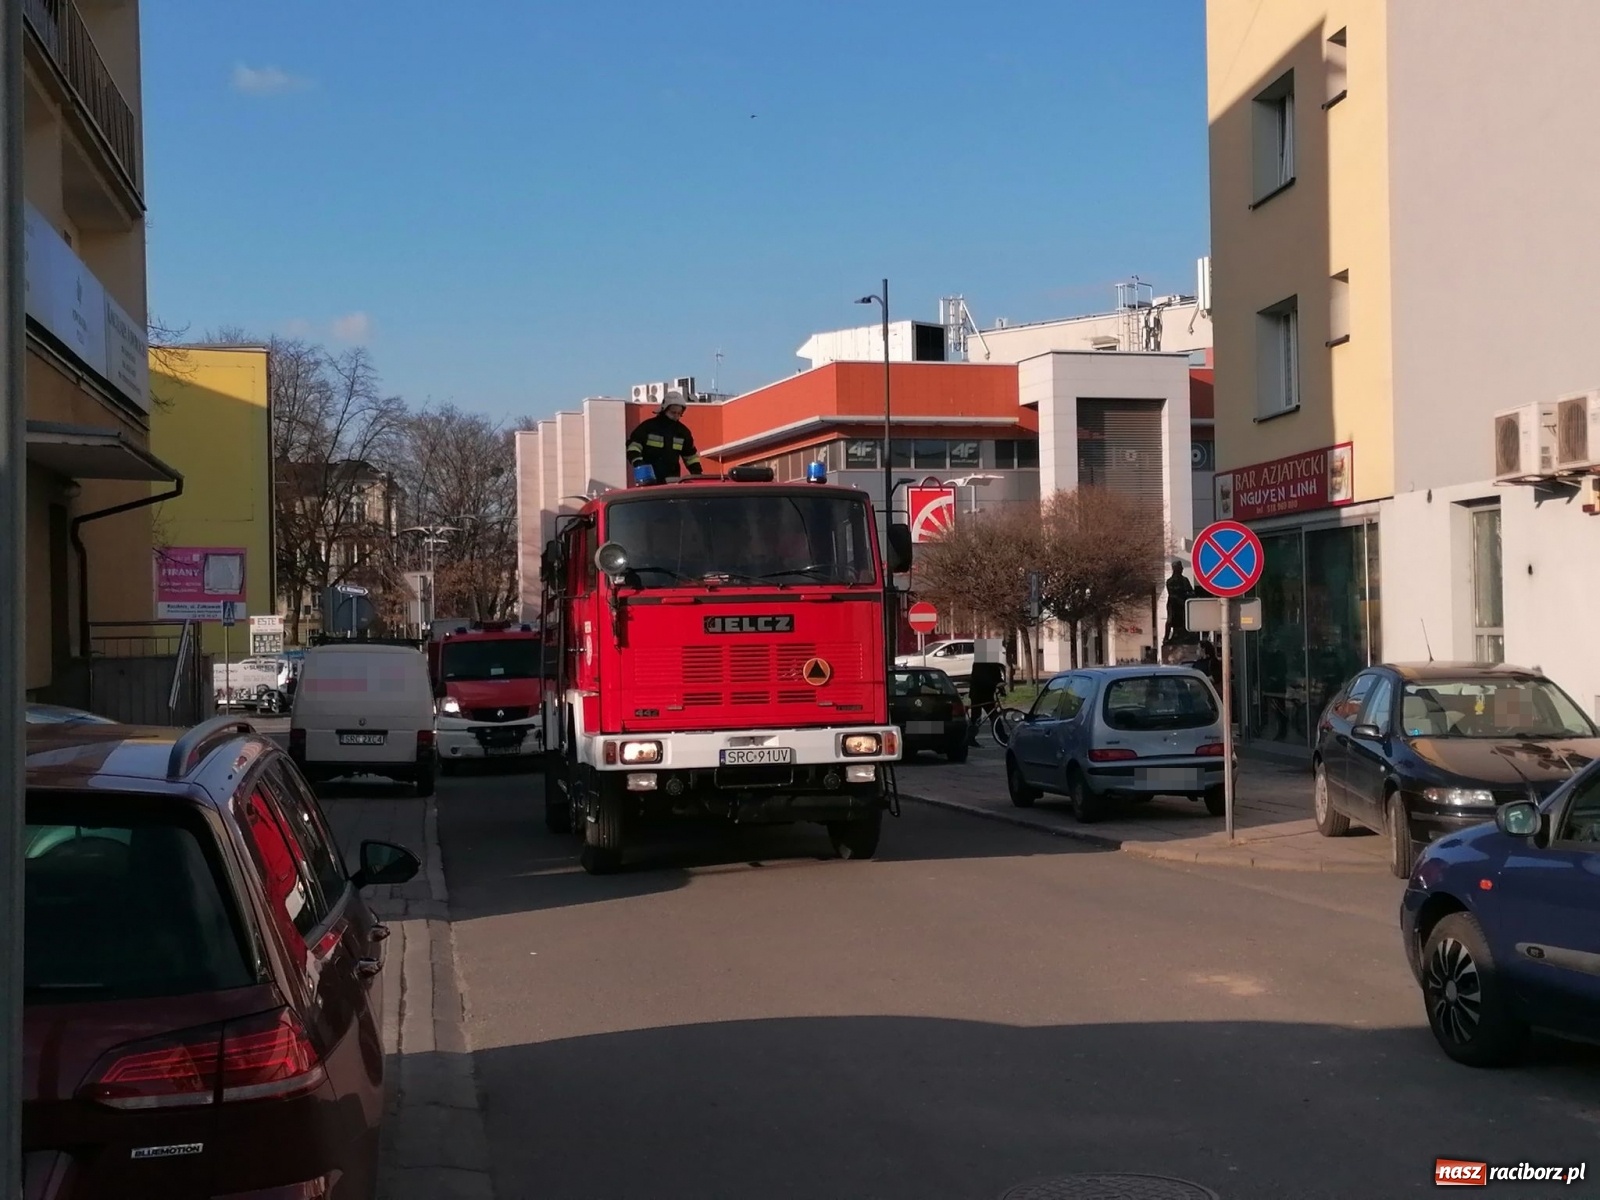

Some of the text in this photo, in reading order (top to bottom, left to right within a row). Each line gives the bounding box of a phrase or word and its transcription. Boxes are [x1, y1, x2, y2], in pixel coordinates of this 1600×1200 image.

[848, 441, 875, 457] 4F
[951, 442, 977, 458] 4F
[1235, 454, 1324, 492] BAR AZJATYCKI
[1240, 485, 1286, 507] NGUYEN
[1289, 478, 1317, 499] LINH
[708, 616, 790, 633] JELCZ
[134, 1145, 200, 1157] BLUEMOTION
